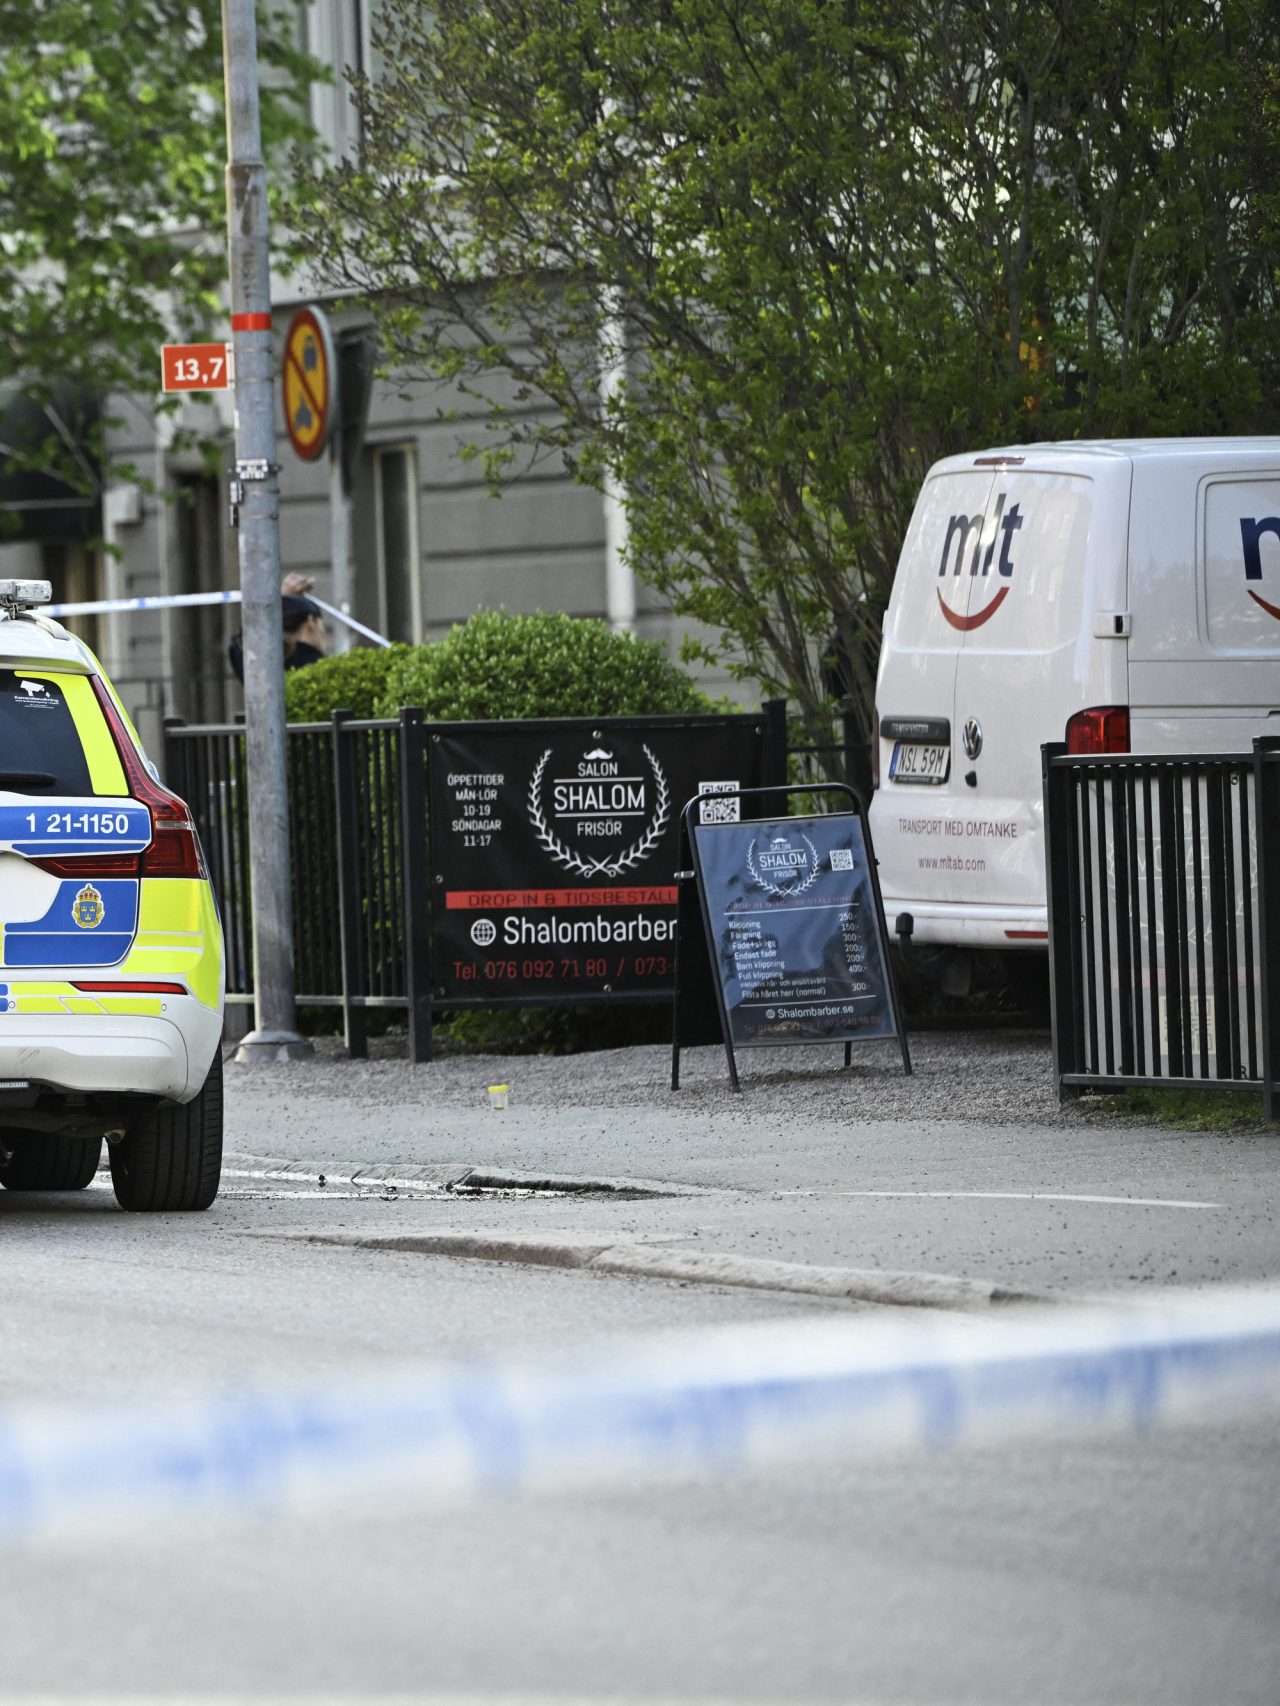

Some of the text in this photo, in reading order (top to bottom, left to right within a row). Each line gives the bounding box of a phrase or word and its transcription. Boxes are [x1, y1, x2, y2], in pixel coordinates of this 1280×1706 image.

[174, 357, 224, 384] 13,7
[938, 493, 1024, 577] mlt
[898, 745, 944, 774] NSL 59M
[577, 762, 618, 777] SALON
[447, 772, 504, 786] ÖPPETTIDER
[455, 788, 498, 801] MÅN-LÖR
[554, 784, 645, 811] SHALOM
[463, 804, 491, 816] 10-19
[26, 812, 129, 834] 1 21-1150
[452, 817, 501, 832] SÖNDAGAR
[577, 818, 622, 836] FRISÖR
[899, 819, 1018, 838] TRANSPORT MED OMTANKE
[463, 834, 491, 847] 11-17
[759, 852, 807, 868] SHALOM
[468, 894, 517, 907] DROP
[523, 893, 538, 906] IN
[503, 914, 678, 945] Shalombarber
[734, 950, 759, 960] Endast
[485, 961, 517, 979] 076
[523, 960, 554, 978] 092
[560, 960, 581, 977] 71
[586, 959, 607, 977] 80
[777, 1005, 854, 1019] Shalombarber.se
